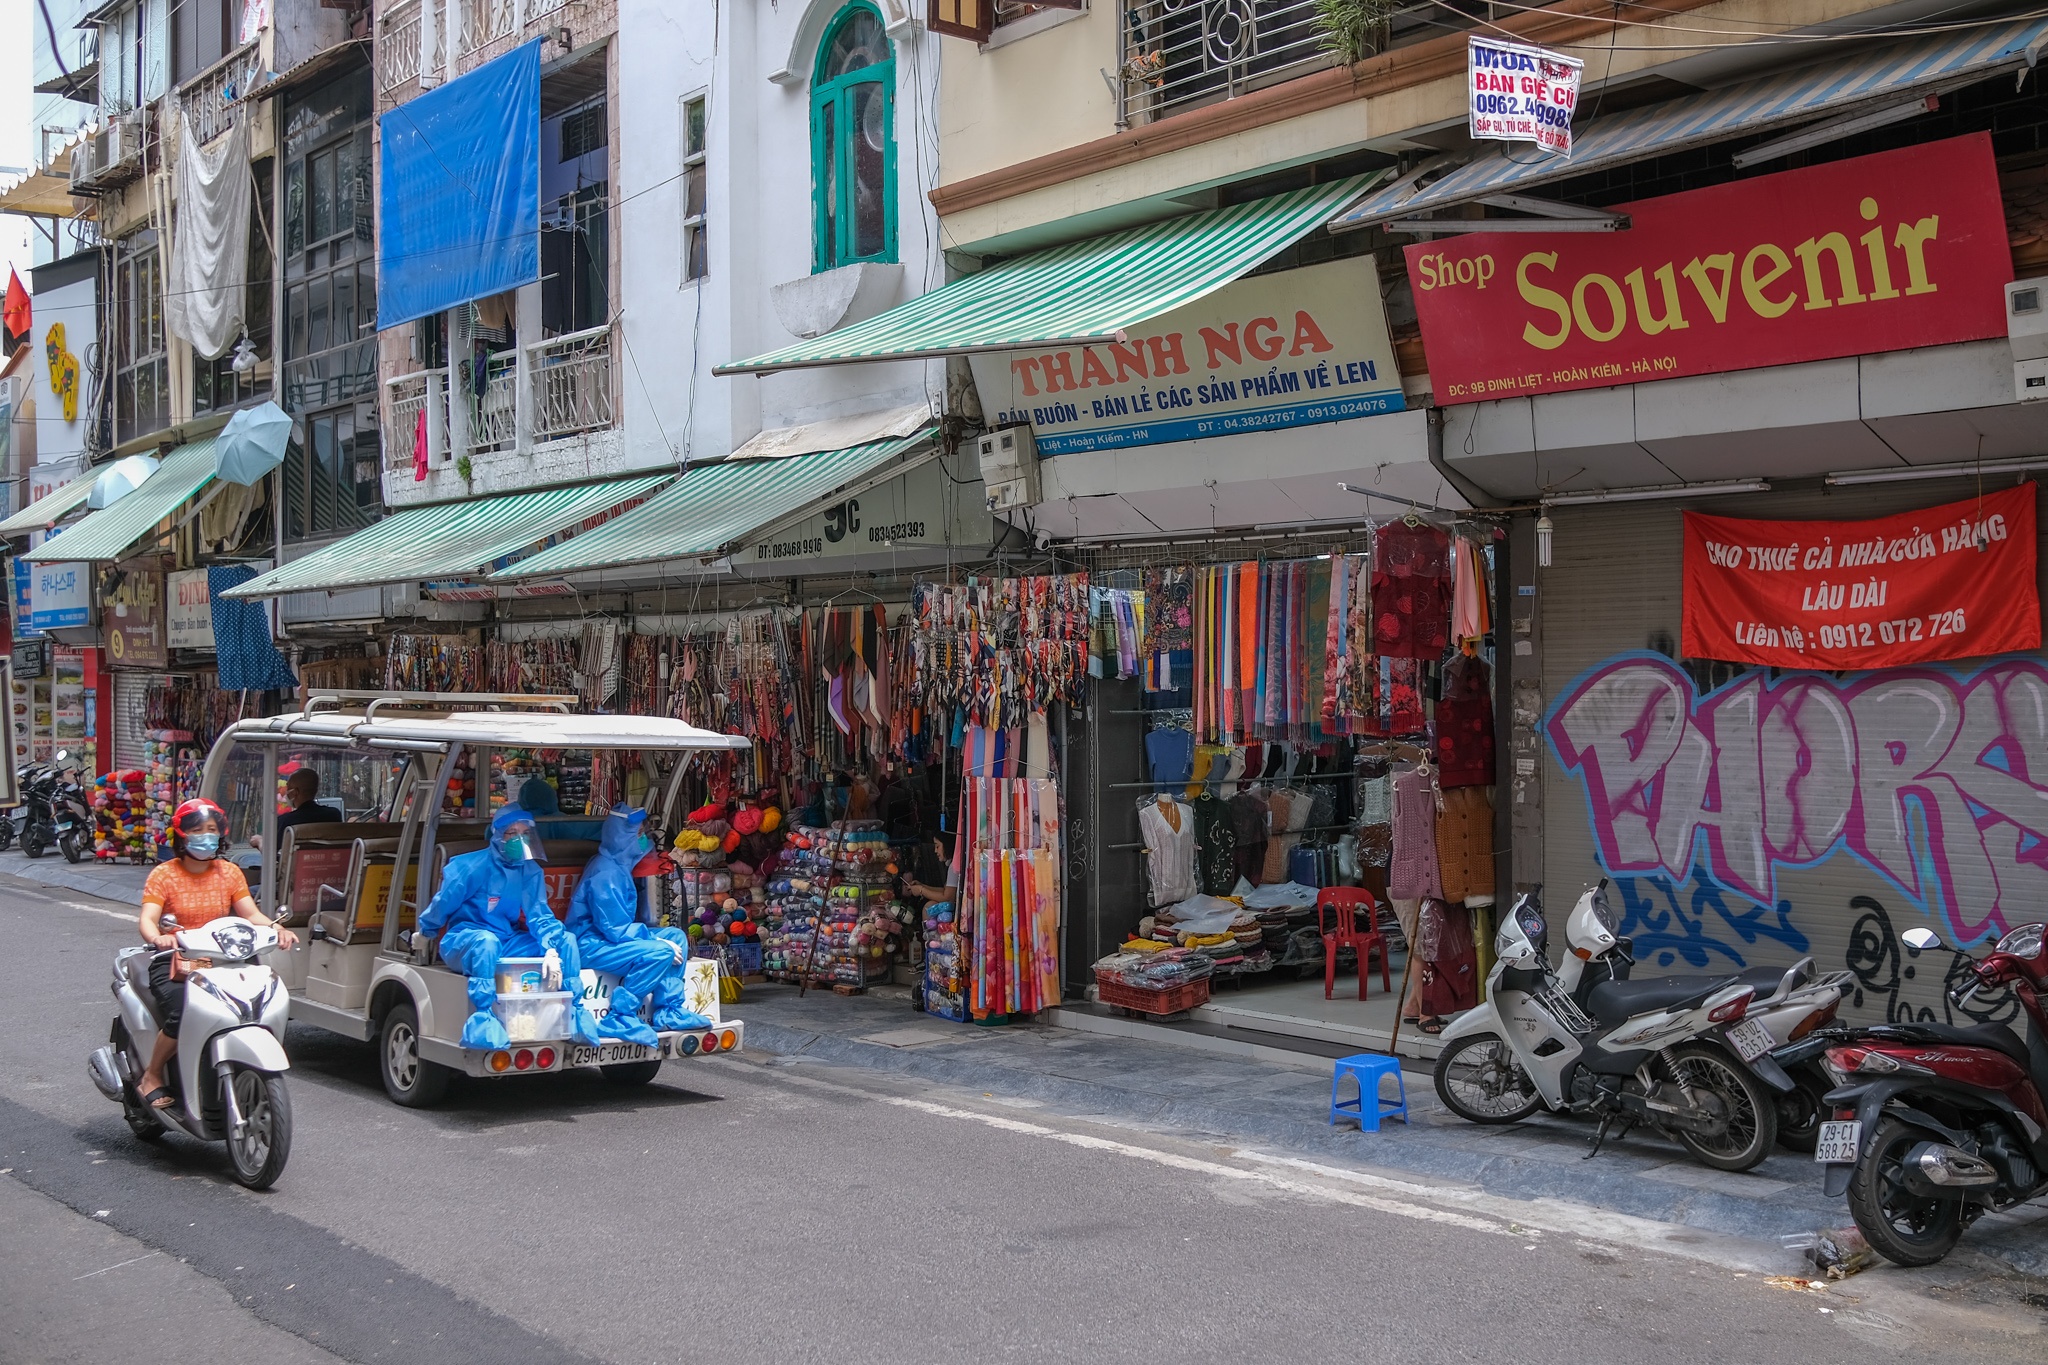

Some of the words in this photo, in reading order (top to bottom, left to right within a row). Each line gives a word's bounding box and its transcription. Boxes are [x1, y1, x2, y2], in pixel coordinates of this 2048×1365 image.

[1475, 46, 1536, 72] MUA
[1475, 70, 1515, 93] BÀN
[1553, 87, 1575, 109] CŨ
[1418, 252, 1495, 291] Shop
[1515, 196, 1939, 350] Souvenir
[1011, 332, 1190, 396] THANH
[1198, 310, 1334, 369] NGA
[1033, 401, 1079, 426] BUÔN
[1092, 394, 1127, 418] BÁN
[1131, 386, 1153, 413] LẺ
[1157, 384, 1193, 410] CÁC
[1197, 374, 1237, 404] SẢN
[1240, 366, 1300, 398] PHẨM
[1304, 359, 1331, 390] VỀ
[1335, 360, 1378, 386] LEN
[1449, 385, 1469, 397] ĐC:
[1470, 381, 1486, 394] 9B
[1488, 377, 1516, 392] ĐINH
[1518, 373, 1543, 389] LIỆT
[1553, 367, 1588, 383] HOÀN
[1632, 358, 1651, 374] HÀ
[1653, 356, 1677, 372] NỘI
[1043, 438, 1062, 452] Liệt
[1069, 435, 1095, 448] Hoàn
[1097, 432, 1124, 444] Kiếm
[1132, 429, 1149, 440] HN
[1198, 422, 1214, 432] ĐT
[1224, 411, 1296, 429] 04.38242767
[1308, 399, 1387, 419] 0913.024076
[758, 544, 771, 559] ĐT:
[772, 543, 801, 558] 083468
[1705, 541, 1742, 569] CHO
[1747, 540, 1799, 571] THUÊ
[1803, 536, 1833, 569] CẢ
[1838, 526, 1936, 568] NHÀ/CỬA
[1941, 514, 2007, 553] HÀNG
[41, 571, 76, 596] 하나스파
[1801, 580, 1845, 611] LÂU
[1849, 576, 1887, 608] DÀI
[114, 634, 120, 654] 9
[1735, 621, 1779, 648] Liên
[1781, 626, 1804, 653] hệ
[1819, 622, 1875, 650] 0912
[1878, 618, 1923, 645] 072
[1928, 608, 1966, 637] 726
[301, 878, 316, 886] SHB
[1740, 1033, 1773, 1059] 035.74
[1818, 1142, 1856, 1160] 588.25
[1823, 1124, 1854, 1142] 29-C1
